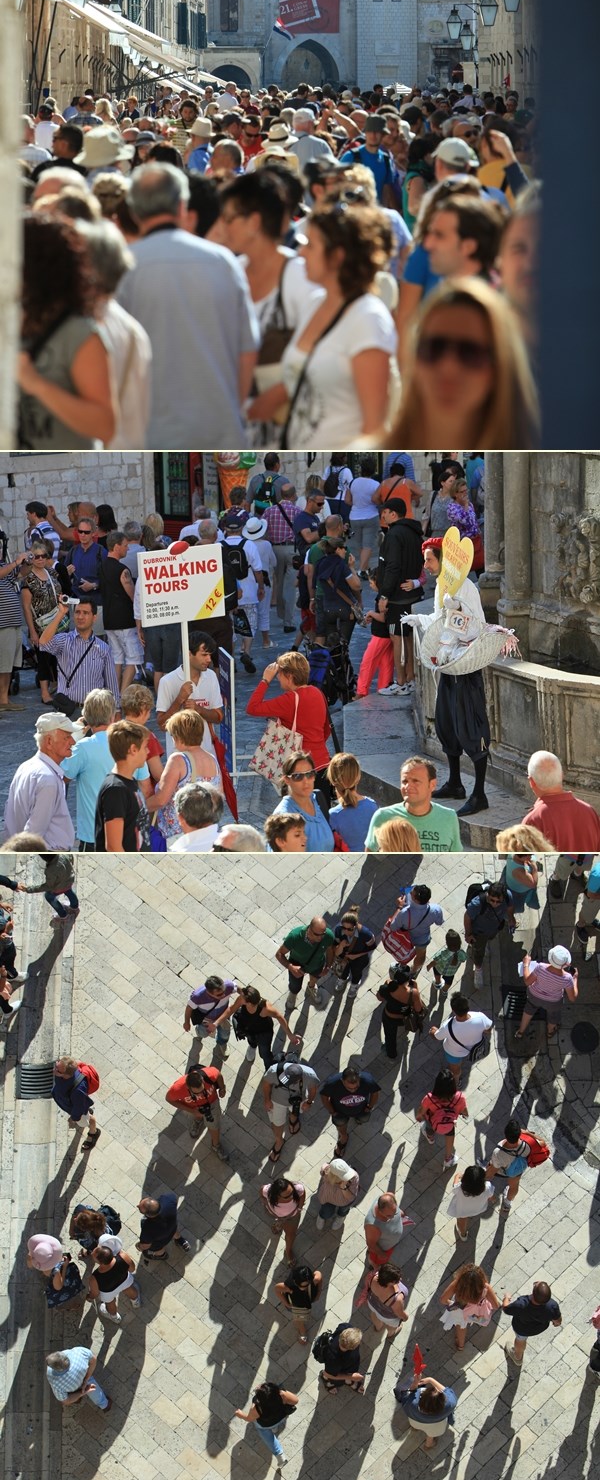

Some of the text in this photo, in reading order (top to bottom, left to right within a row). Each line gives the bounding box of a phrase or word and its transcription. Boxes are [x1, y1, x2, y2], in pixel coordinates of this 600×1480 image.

[279, 3, 293, 15] 21.
[143, 556, 177, 564] DUBROVNIK
[144, 559, 218, 580] WALKING
[145, 579, 189, 595] TOURS
[205, 598, 217, 611] 12
